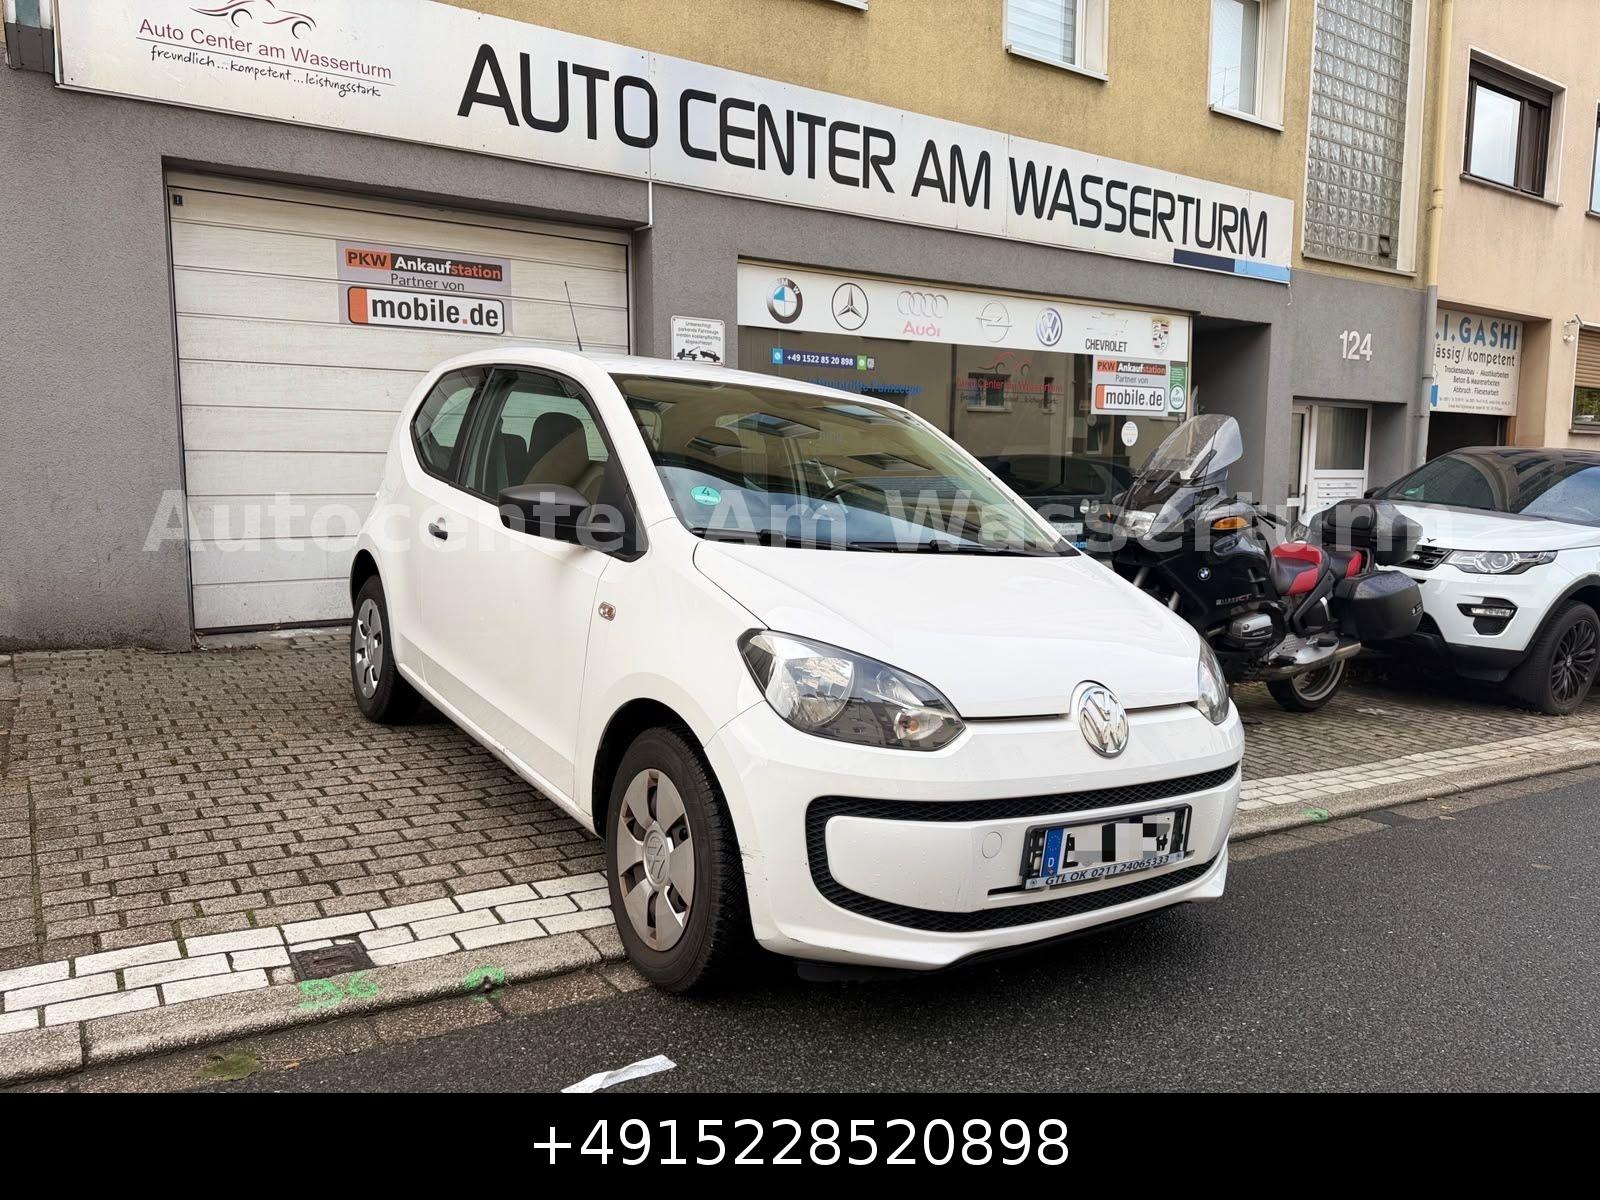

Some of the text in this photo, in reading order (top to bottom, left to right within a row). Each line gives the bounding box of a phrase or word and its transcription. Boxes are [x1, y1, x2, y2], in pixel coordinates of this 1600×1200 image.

[138, 18, 393, 80] Auto Center am Wasserturm
[457, 43, 1268, 259] AUTO CENTER AM WASSERTURM
[347, 251, 502, 280] PKW Ankaufstation
[390, 273, 465, 292] Partner von
[371, 297, 499, 328] mobile.de
[902, 321, 941, 338] Audi
[1084, 338, 1128, 353] CHEVROLET
[1338, 330, 1373, 362] 124
[787, 353, 854, 366] +49 1522 85 20 898
[1467, 347, 1515, 367] kompetent
[1097, 361, 1166, 375] PKW Ankaufstation
[1115, 374, 1137, 384] Partner
[1105, 388, 1163, 407] mobile.de
[701, 487, 710, 496] 4
[1045, 855, 1169, 885] GTL OK 0211 24065333
